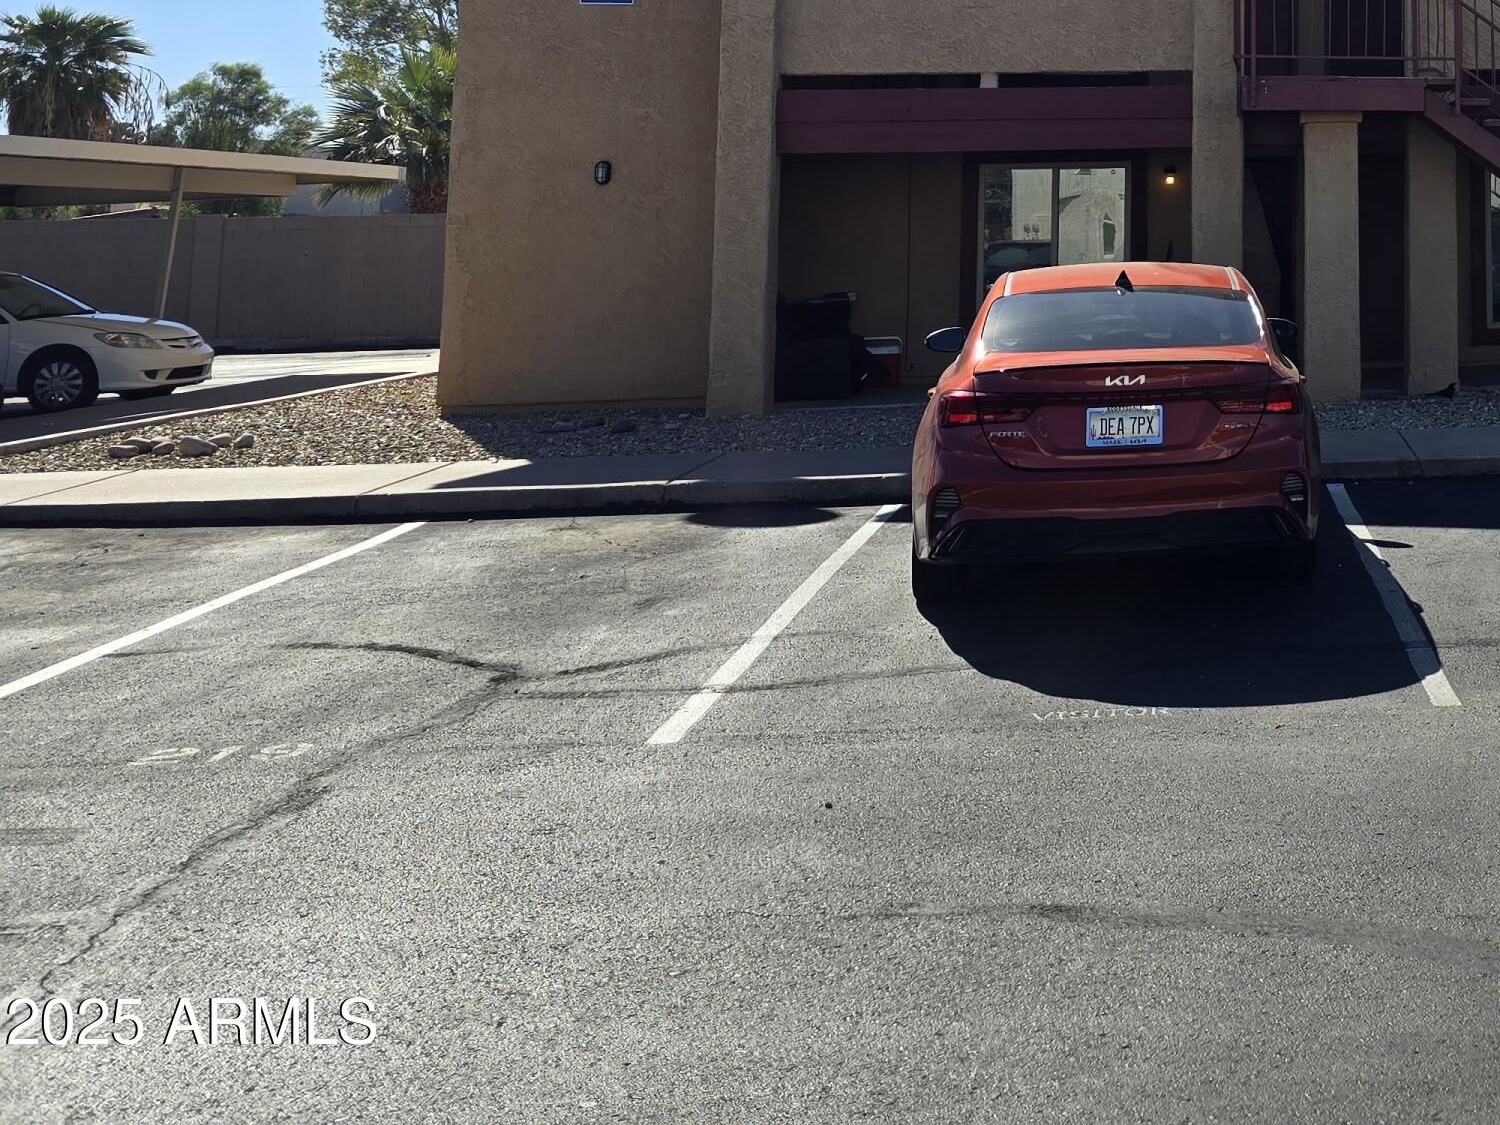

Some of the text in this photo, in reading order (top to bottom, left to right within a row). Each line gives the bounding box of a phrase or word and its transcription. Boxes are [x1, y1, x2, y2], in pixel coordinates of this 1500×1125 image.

[1105, 374, 1146, 386] KIA
[1100, 416, 1154, 436] DEA 7PX
[1032, 706, 1173, 722] VISITOR
